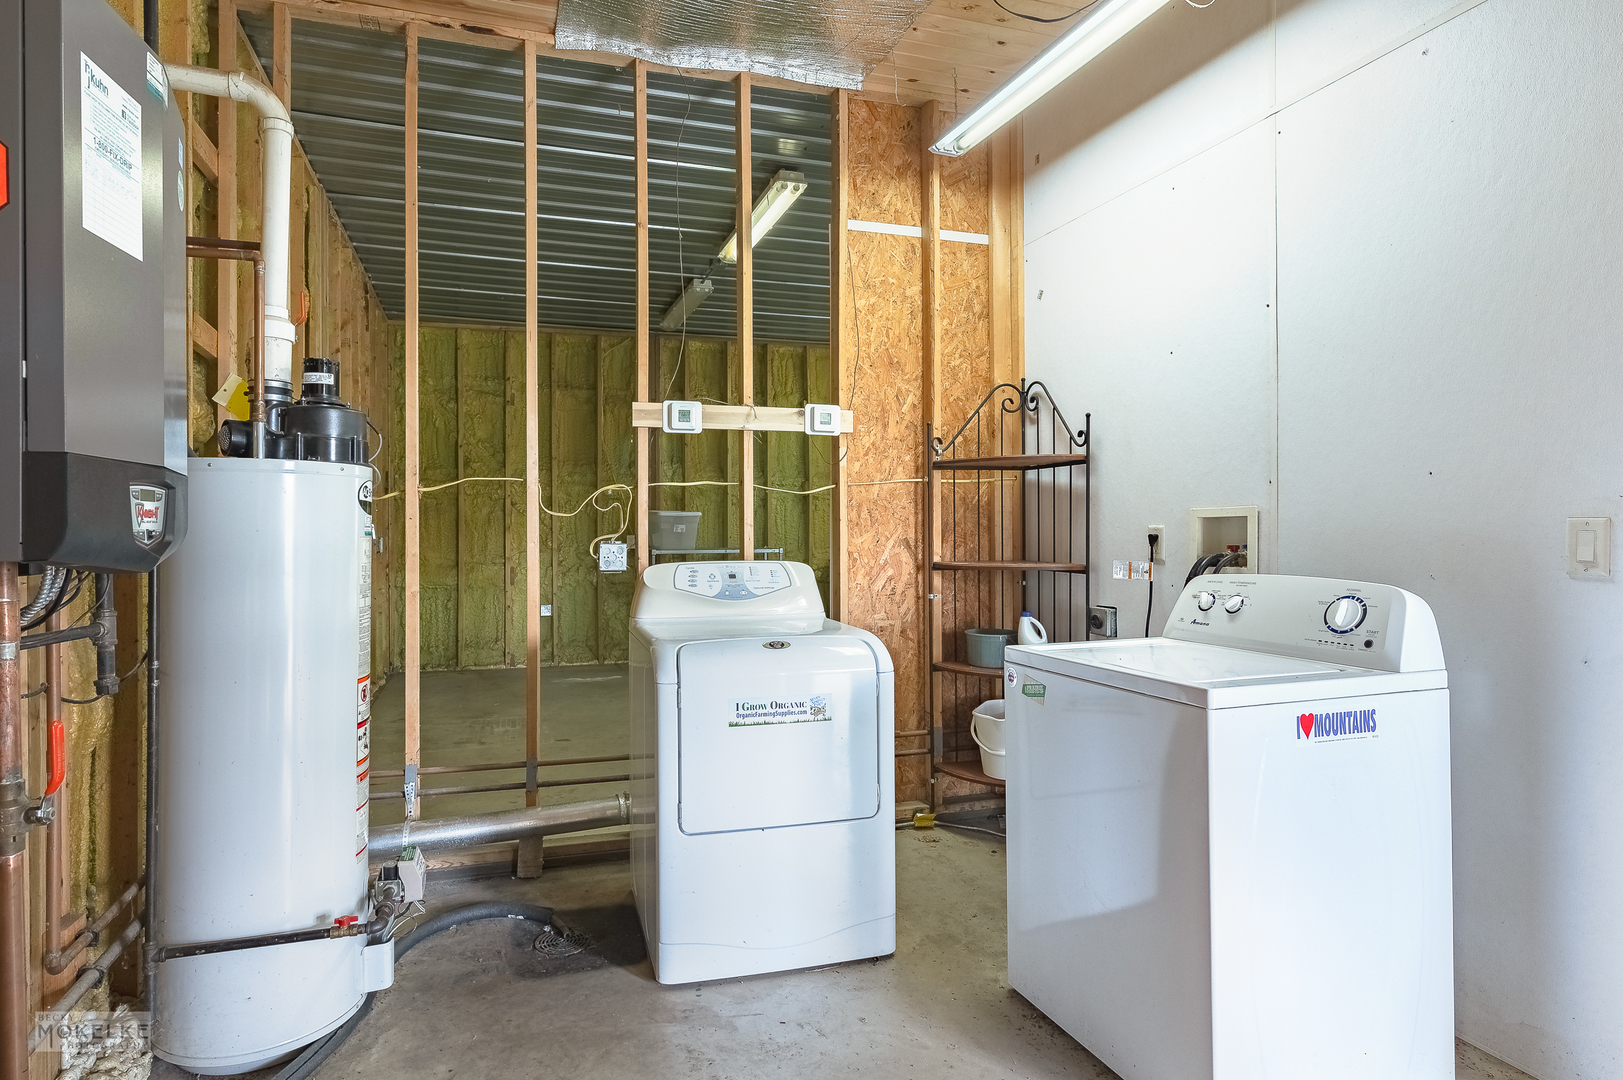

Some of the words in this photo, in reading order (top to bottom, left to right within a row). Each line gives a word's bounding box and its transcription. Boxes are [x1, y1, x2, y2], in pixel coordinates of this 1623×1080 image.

[90, 68, 109, 97] kuhn
[736, 702, 740, 712] I
[736, 710, 808, 719] OrganicFarmingSupplies.com
[1296, 715, 1301, 740] I
[1314, 708, 1377, 738] MOUNTAINS
